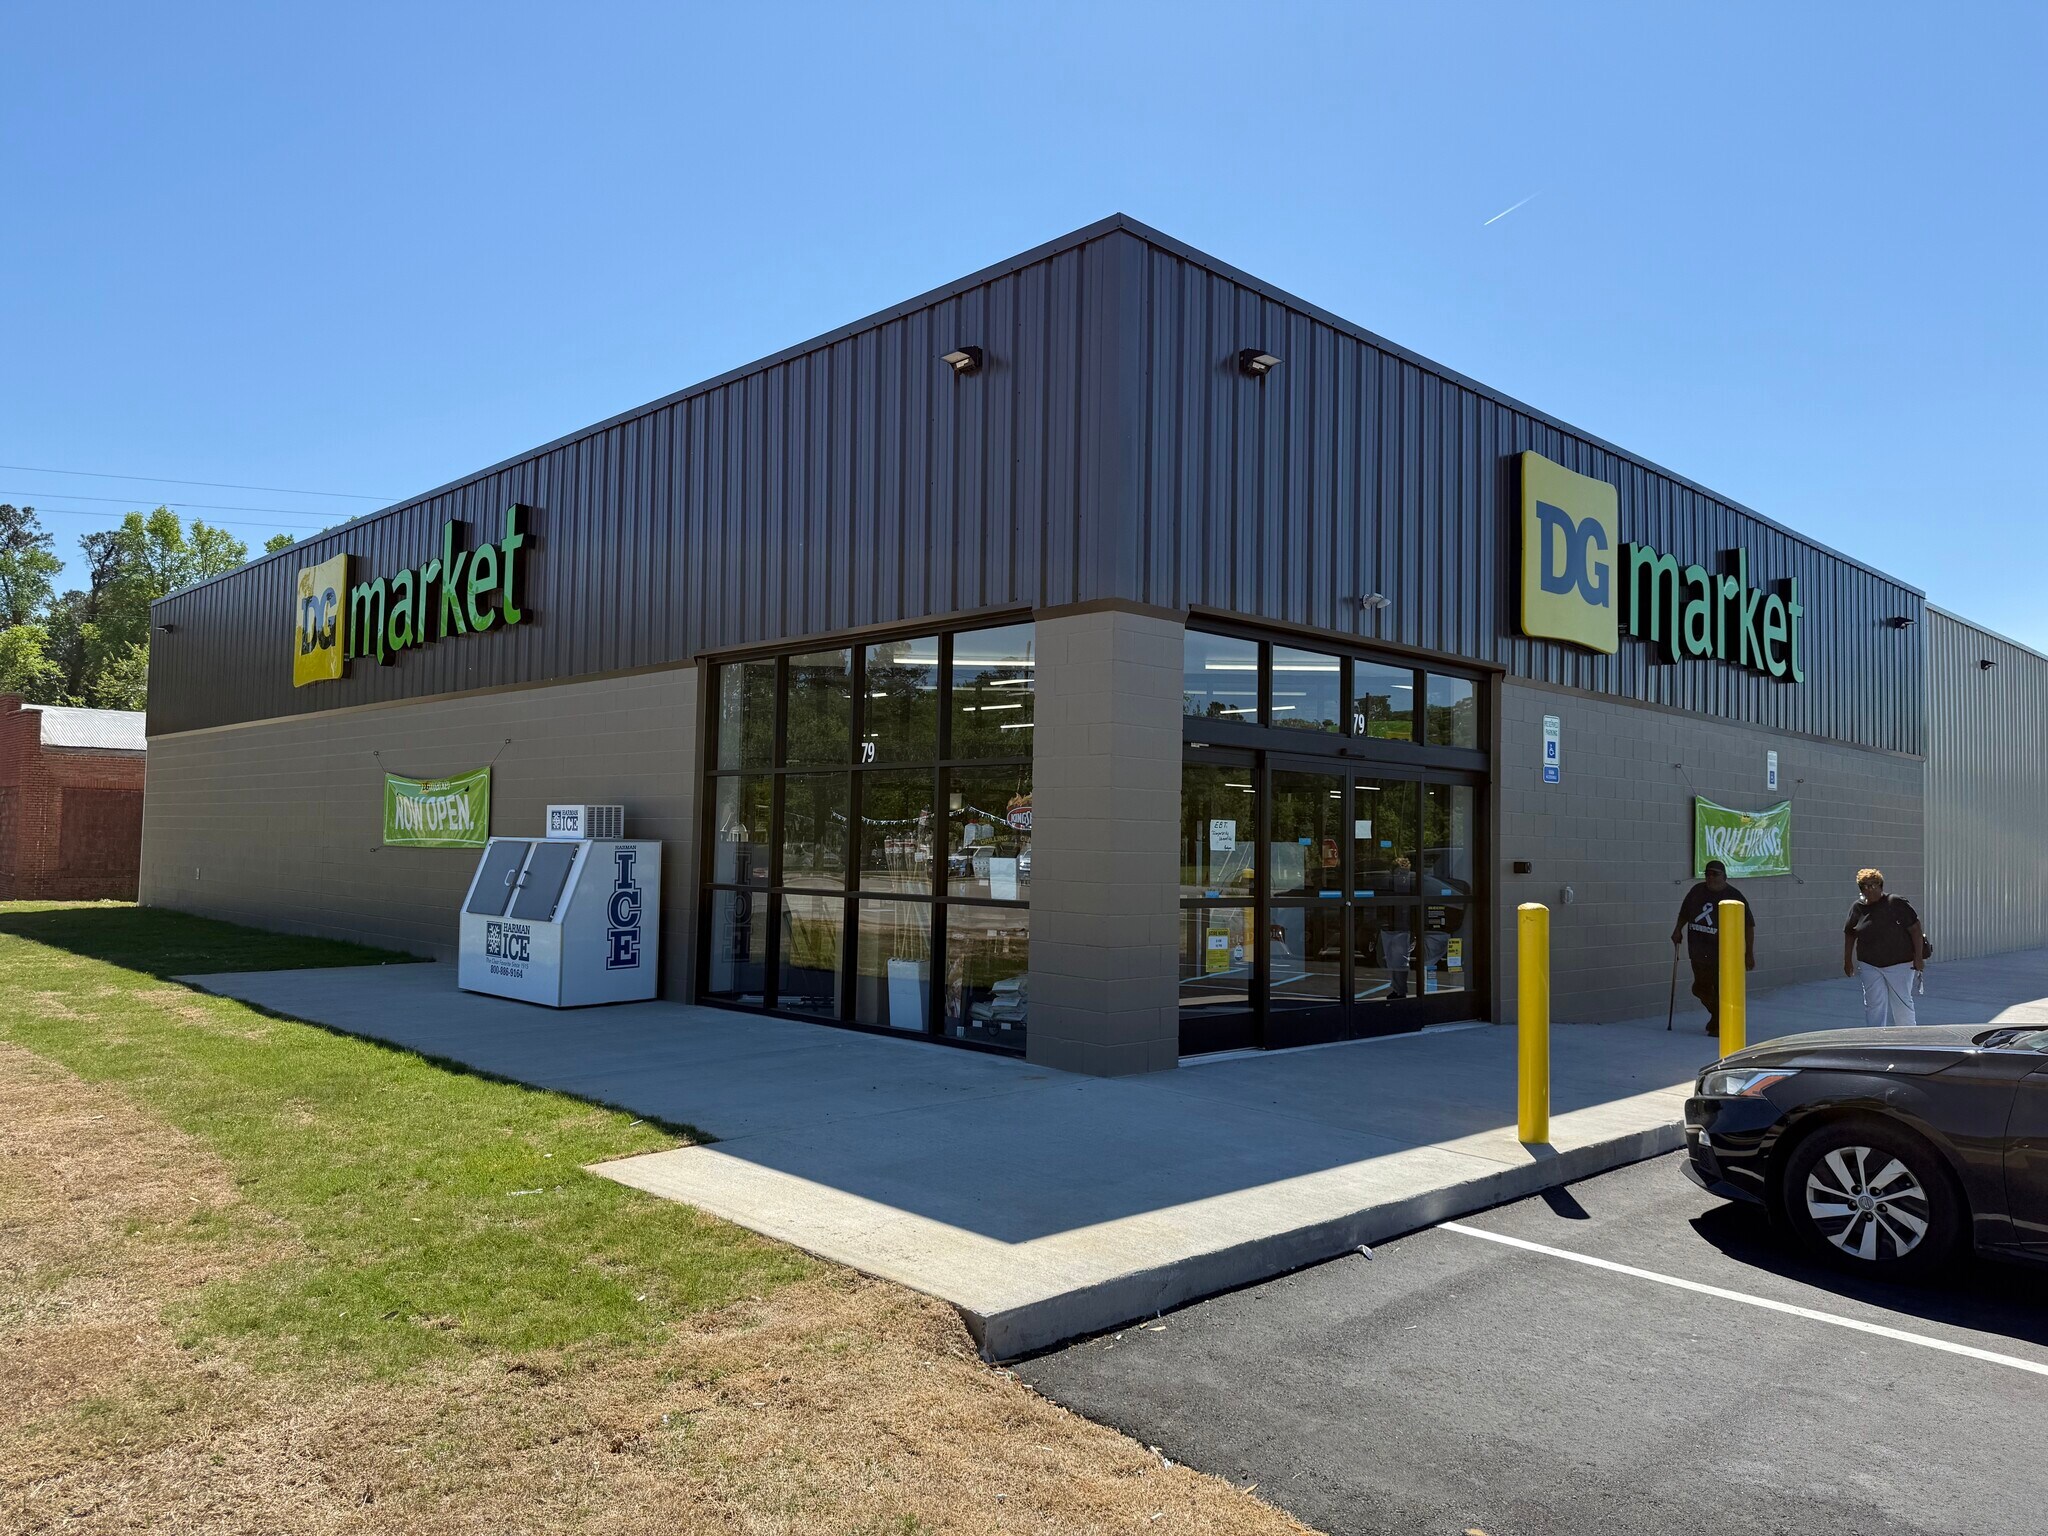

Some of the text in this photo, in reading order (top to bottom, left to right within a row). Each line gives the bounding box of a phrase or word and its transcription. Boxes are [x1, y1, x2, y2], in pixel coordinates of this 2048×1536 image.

[302, 503, 525, 666] DG market
[1536, 500, 1804, 683] DG market
[1353, 713, 1365, 735] 79
[861, 742, 875, 763] 79
[395, 794, 474, 830] NOW OPEN.
[562, 816, 578, 831] ICE
[1705, 825, 1743, 857] NOW
[606, 850, 641, 970] ICE
[503, 922, 530, 935] HARMAN
[502, 933, 530, 962] ICE
